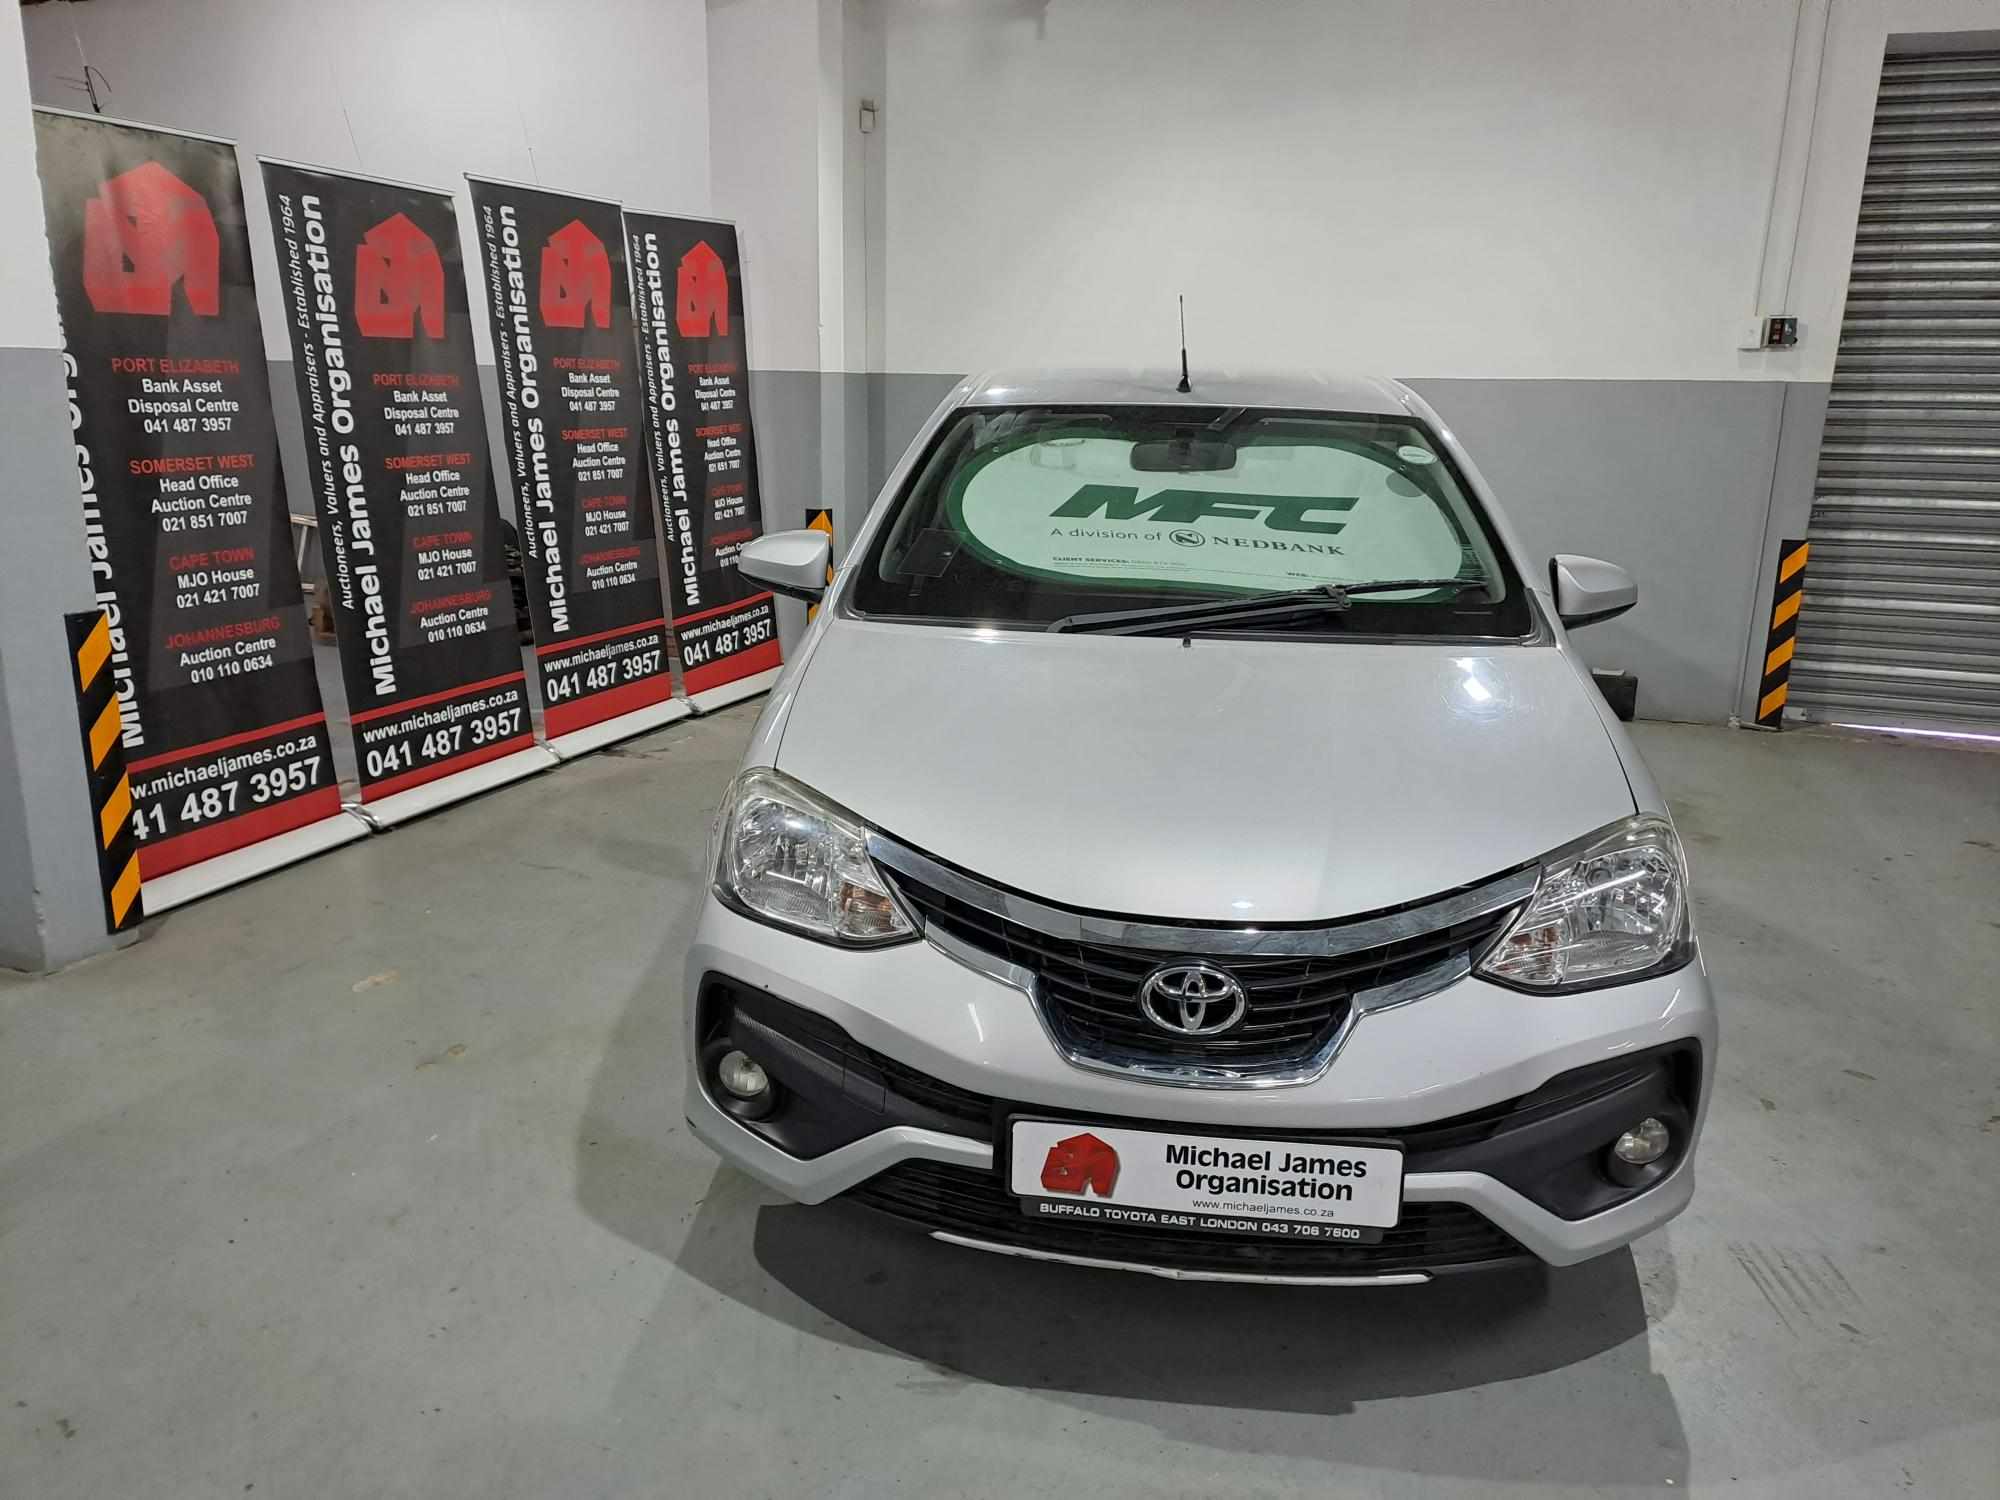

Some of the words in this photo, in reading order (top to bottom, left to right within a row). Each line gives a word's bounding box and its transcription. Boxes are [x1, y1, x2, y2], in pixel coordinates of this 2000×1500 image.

[278, 193, 297, 235] 1964
[483, 205, 495, 239] 1964
[284, 236, 310, 331] Established
[489, 242, 505, 319] Established
[301, 194, 354, 435] Organisation
[500, 205, 539, 409] Organisation
[644, 233, 677, 411] Organisation
[111, 357, 155, 374] PORT
[160, 358, 240, 374] ELIZABETH
[500, 330, 516, 399] Appraisers
[142, 378, 179, 393] Bank
[183, 378, 222, 393] Asset
[304, 343, 326, 425] Appraisers
[393, 390, 419, 402] Bank
[421, 390, 448, 402] Asset
[561, 387, 594, 399] Disposal
[128, 399, 191, 417] Disposal
[195, 399, 239, 414] Centre
[384, 407, 428, 420] Disposal
[430, 406, 460, 418] Centre
[505, 402, 520, 425] and
[144, 418, 169, 433] 041
[173, 418, 198, 433] 487
[202, 417, 232, 432] 3957
[313, 427, 329, 454] and
[395, 423, 411, 435] 041
[415, 422, 431, 434] 487
[434, 422, 454, 434] 3957
[129, 457, 214, 475] SOMERSET
[218, 454, 255, 469] WEST
[511, 429, 527, 477] Valuers
[528, 418, 554, 513] James
[572, 457, 600, 468] Auction
[665, 418, 688, 501] James
[160, 478, 195, 494] Head
[200, 474, 239, 490] Office
[321, 457, 339, 516] Valuers
[400, 488, 438, 501] Auction
[439, 485, 470, 497] Centre
[405, 472, 430, 485] Head
[432, 470, 460, 482] Office
[151, 495, 205, 514] Auction
[208, 493, 252, 508] Centre
[340, 444, 374, 556] James
[408, 505, 424, 517] 021
[427, 503, 443, 515] 851
[446, 500, 466, 512] 7007
[603, 510, 626, 520] House
[1049, 484, 1360, 535] MFC
[162, 516, 186, 532] 021
[190, 513, 215, 530] 851
[218, 510, 248, 526] 7007
[518, 481, 538, 559] Auctioneers,
[418, 551, 440, 564] MJO
[441, 548, 472, 560] House
[675, 508, 700, 606] Michael
[1050, 528, 1063, 537] A
[1068, 527, 1138, 540] division
[1144, 531, 1161, 541] of
[1213, 536, 1346, 556] NEDBANK
[169, 552, 209, 570] CAPE
[213, 547, 255, 565] TOWN
[331, 519, 356, 610] Auctioneers,
[418, 568, 434, 580] 021
[437, 564, 453, 577] 421
[455, 561, 476, 574] 7007
[586, 565, 613, 577] Auction
[177, 571, 208, 589] MJO
[212, 567, 254, 585] House
[538, 521, 570, 633] Michael
[176, 593, 200, 609] 021
[203, 588, 228, 605] 421
[230, 583, 260, 601] 7007
[165, 617, 281, 649] JOHANNESBURG
[354, 564, 397, 697] Michael
[420, 613, 456, 628] Auction
[458, 607, 488, 620] Centre
[428, 630, 444, 643] 010
[447, 626, 463, 639] 110
[465, 621, 487, 634] 0634
[680, 604, 769, 641] www.michaeljames.co.za
[179, 645, 231, 667] Auction
[235, 637, 276, 654] Centre
[544, 633, 659, 673] www.michaeljames.co.za
[683, 641, 711, 667] 041
[715, 629, 740, 654] 487
[743, 618, 772, 647] 3957
[191, 667, 214, 683] 010
[217, 661, 240, 679] 110
[243, 654, 273, 674] 0634
[546, 674, 580, 701] 041
[587, 662, 617, 690] 487
[622, 650, 661, 679] 3957
[363, 689, 519, 744] www.michaeljames.co.za
[365, 745, 413, 778] 041
[420, 724, 463, 759] 487
[470, 707, 522, 744] 3957
[130, 734, 316, 800] w.michaeljames.co.za
[132, 802, 167, 841] 41
[180, 780, 240, 824] 487
[251, 756, 322, 803] 3957
[1166, 1143, 1271, 1172] Michael
[1278, 1152, 1367, 1178] James
[1176, 1168, 1353, 1202] Organisation
[1039, 1203, 1100, 1218] BUFFALO
[1104, 1209, 1157, 1224] TOYOTA
[1160, 1214, 1196, 1226] EAST
[1200, 1218, 1258, 1232] LONDON
[1261, 1223, 1291, 1235] 043
[1192, 1199, 1335, 1219] www.michaeljames.co.za
